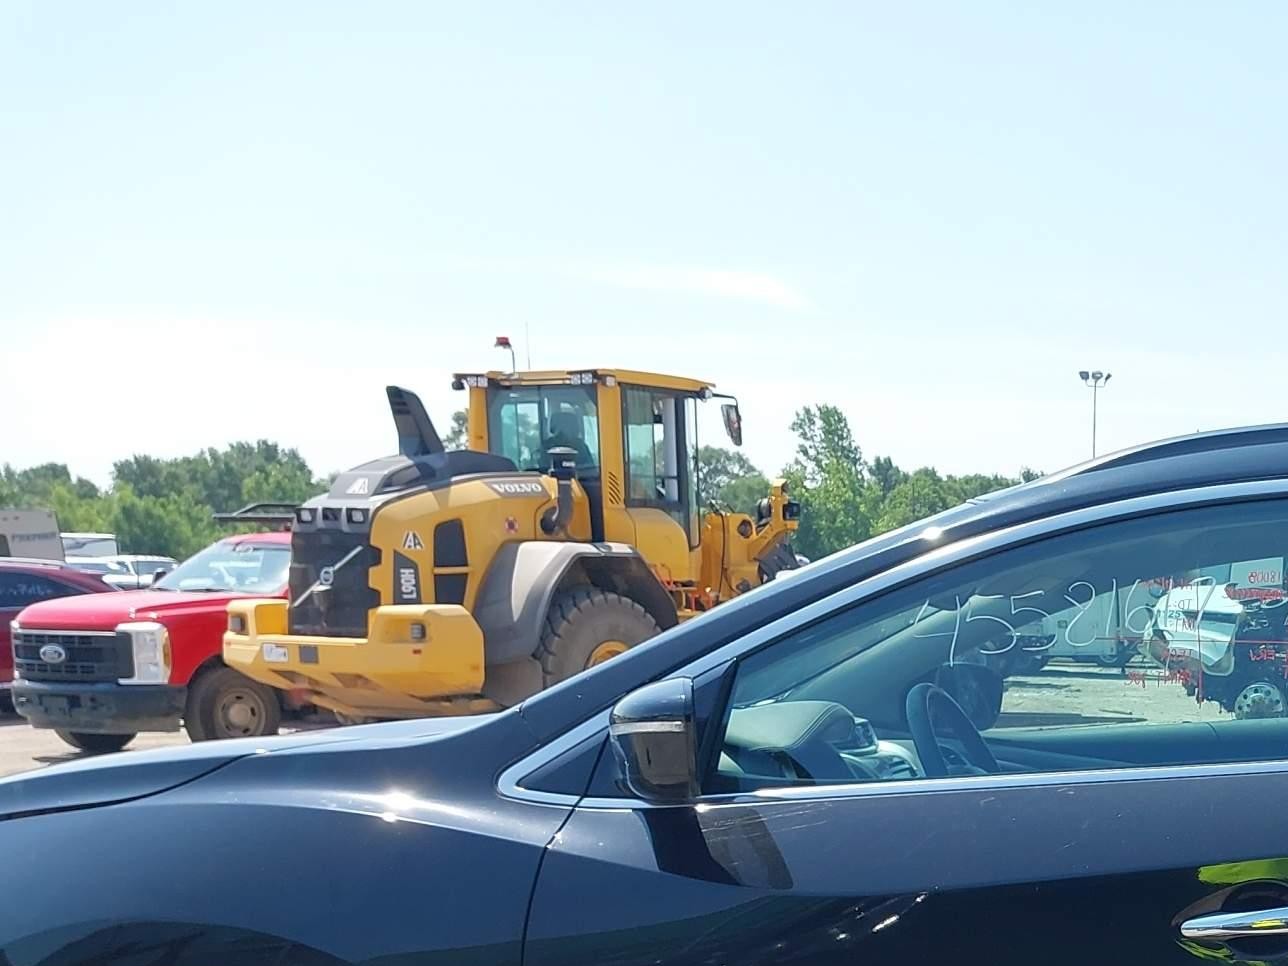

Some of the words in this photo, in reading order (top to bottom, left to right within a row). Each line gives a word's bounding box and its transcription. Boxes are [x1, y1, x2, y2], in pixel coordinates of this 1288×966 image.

[491, 483, 541, 493] VOLVO
[400, 568, 417, 599] L90H
[909, 576, 1217, 667] 45581617
